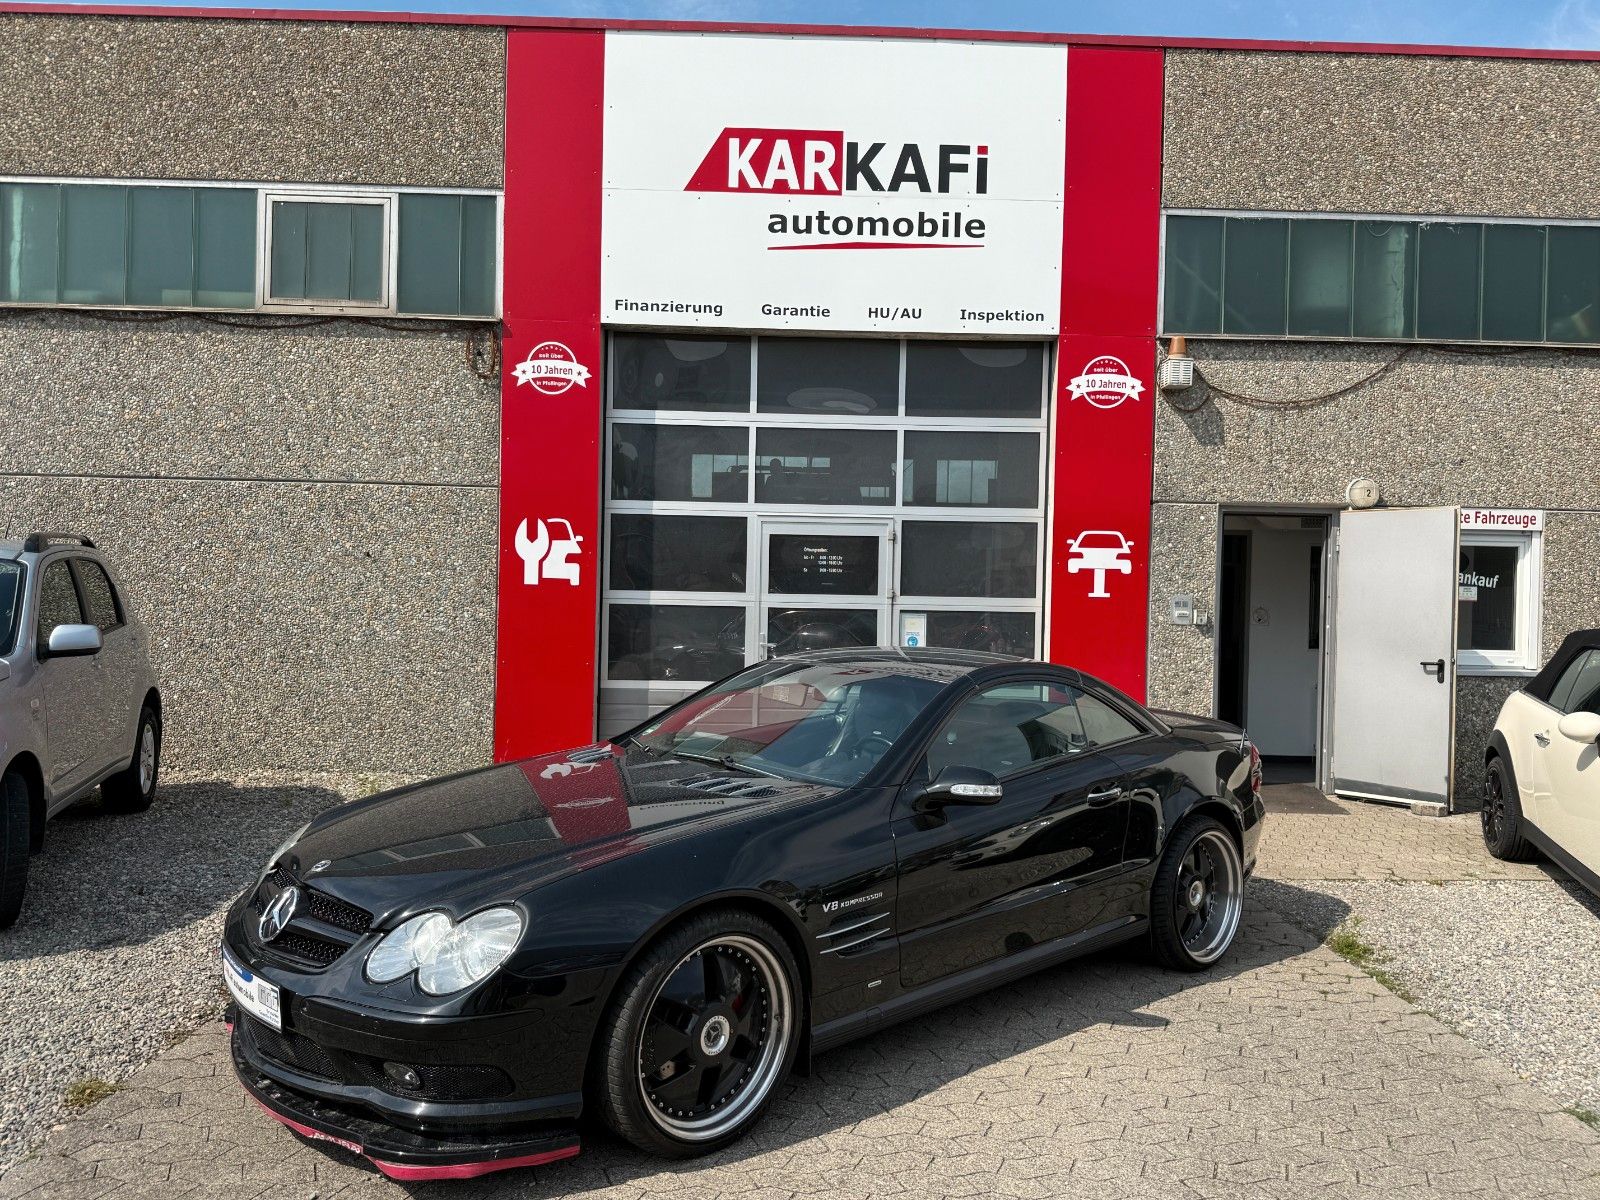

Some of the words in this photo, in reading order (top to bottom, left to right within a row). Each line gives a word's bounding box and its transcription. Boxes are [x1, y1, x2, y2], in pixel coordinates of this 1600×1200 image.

[767, 210, 986, 239] automobile
[614, 299, 723, 317] Finanzierung
[761, 303, 831, 318] Garantie
[868, 307, 922, 321] HU/AU
[959, 309, 1045, 323] Inspektion
[531, 365, 542, 374] 10
[544, 365, 573, 376] Jahren
[1086, 379, 1096, 388] 10
[1098, 380, 1127, 389] Jahren
[1366, 489, 1371, 498] 2
[1474, 511, 1537, 529] Fahrzeuge
[1458, 571, 1499, 589] ankauf
[822, 900, 839, 913] V8
[840, 891, 883, 908] KOMPRESSOR
